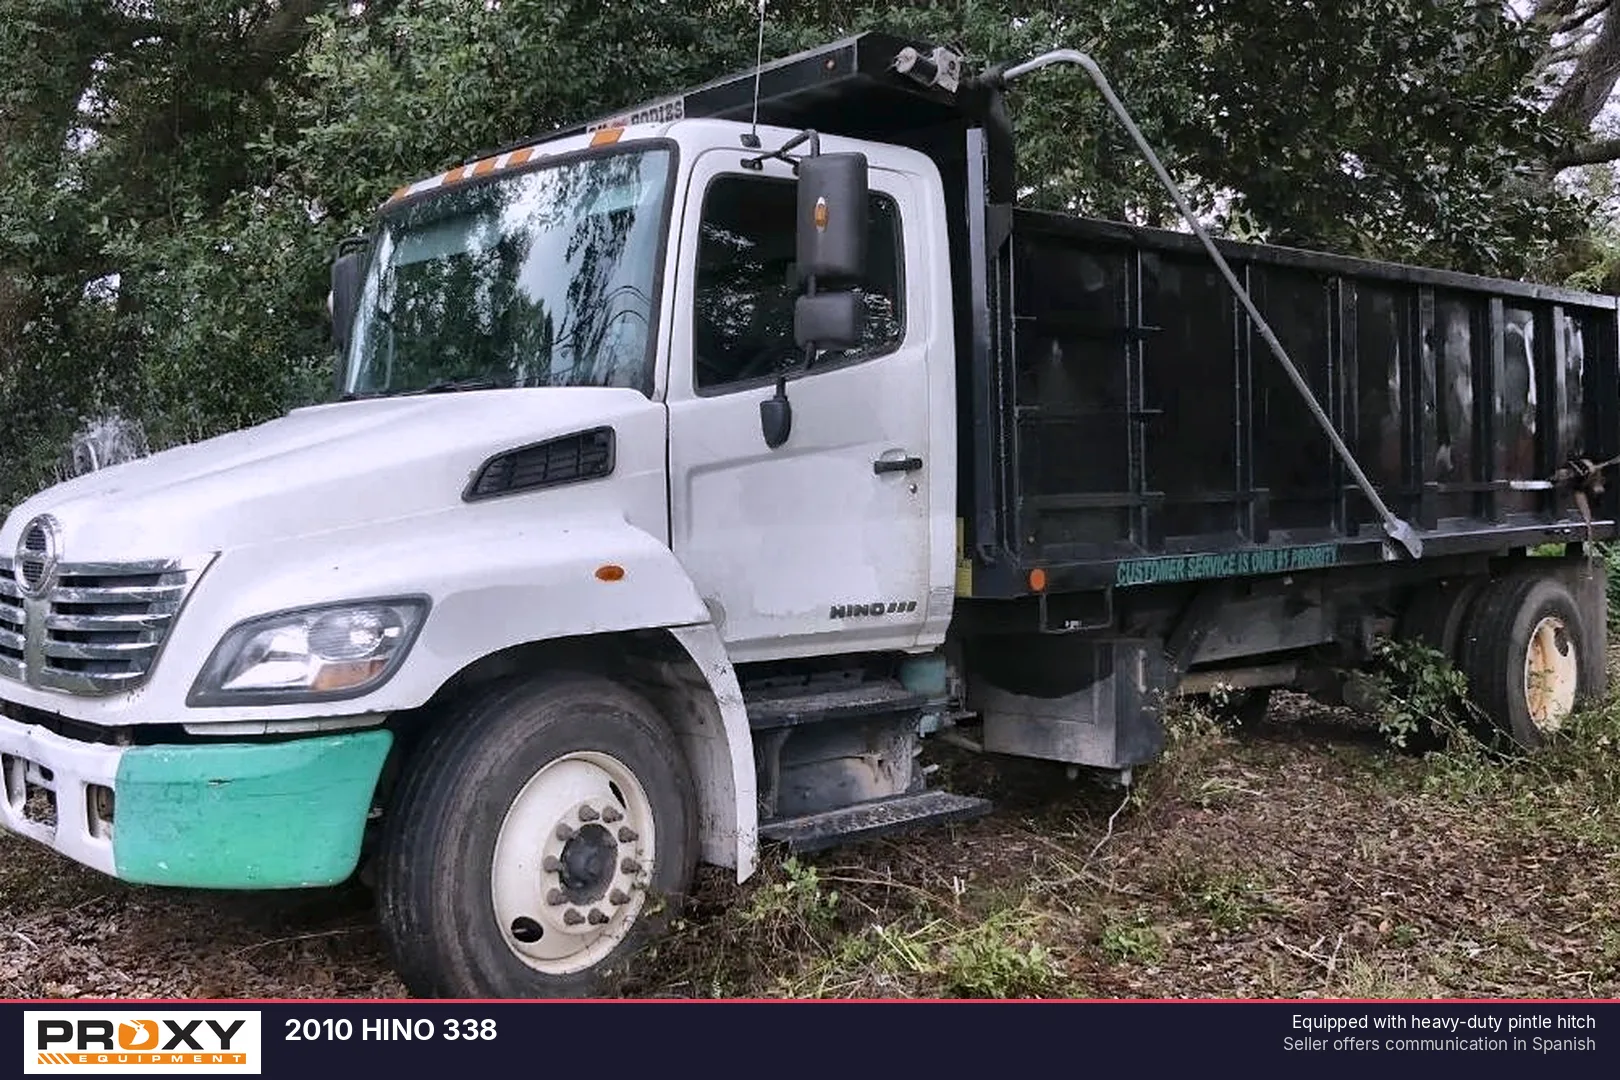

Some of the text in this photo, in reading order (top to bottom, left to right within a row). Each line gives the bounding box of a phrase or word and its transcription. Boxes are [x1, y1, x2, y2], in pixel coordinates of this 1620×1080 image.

[1116, 558, 1184, 584] CUSTOMER
[1188, 553, 1235, 578] SERVICE
[1239, 552, 1250, 571] IS
[1252, 550, 1275, 571] OUR
[830, 603, 885, 619] HINO
